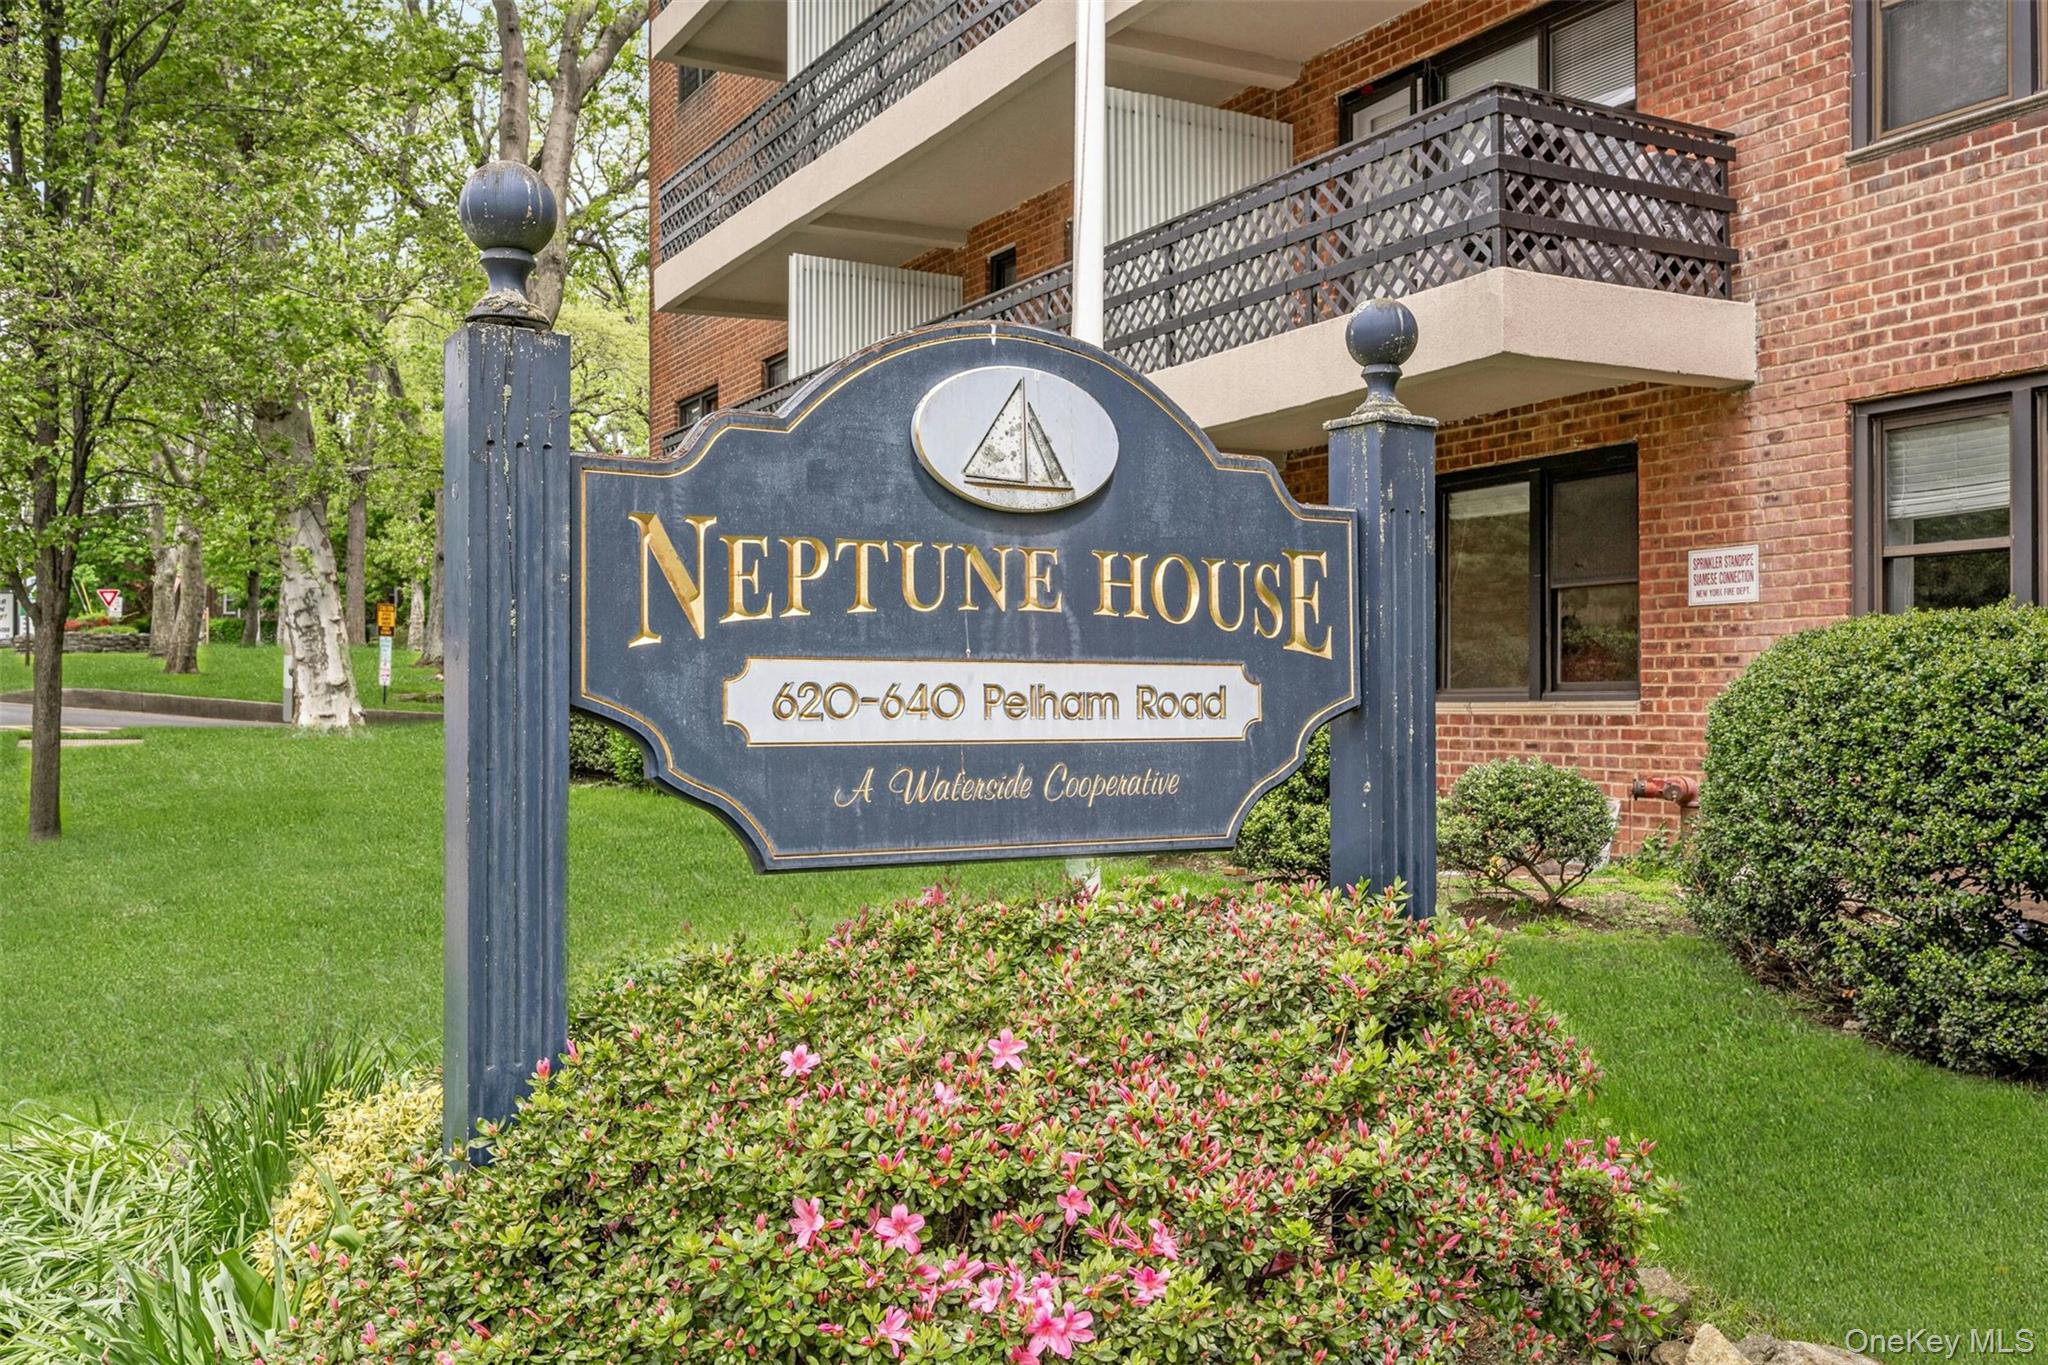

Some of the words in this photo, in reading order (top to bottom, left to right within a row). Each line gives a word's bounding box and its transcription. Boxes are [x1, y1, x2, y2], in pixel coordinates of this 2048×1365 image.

[1693, 556, 1723, 570] SPRINKLER
[628, 511, 1063, 648] NEPTUNE
[1091, 548, 1334, 661] HOUSE
[1693, 572, 1718, 586] SIAMESE
[1719, 570, 1754, 584] CONNECTION
[1696, 589, 1708, 598] NEW
[1709, 588, 1723, 597] YORK
[1724, 587, 1735, 596] FIRE
[772, 681, 966, 722] 620-640
[983, 682, 1119, 721] Pelham
[1136, 684, 1228, 720] Road
[834, 767, 874, 808] A
[889, 763, 1033, 805] Waterside
[1044, 762, 1181, 808] Cooperative
